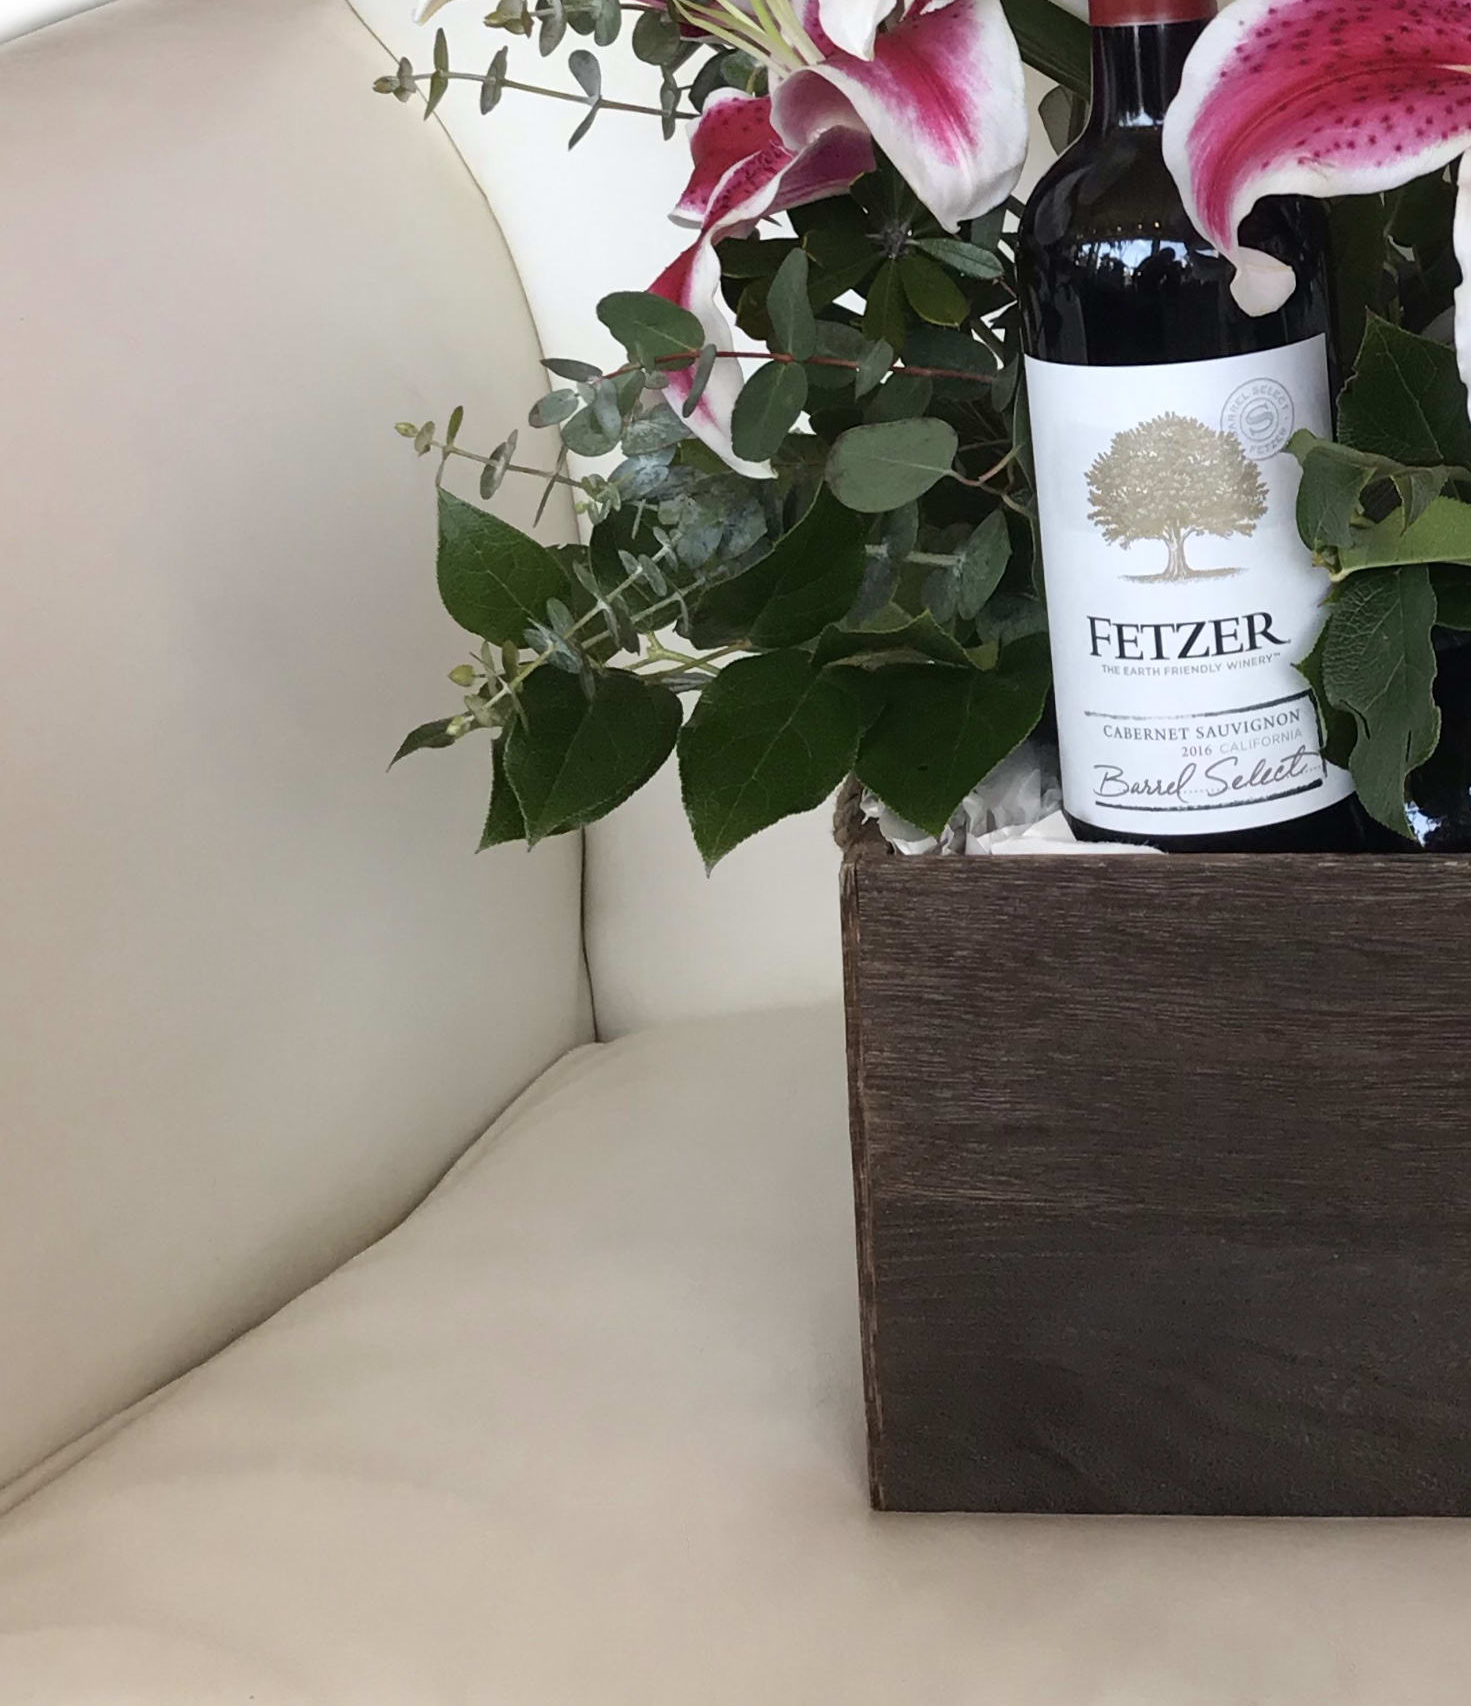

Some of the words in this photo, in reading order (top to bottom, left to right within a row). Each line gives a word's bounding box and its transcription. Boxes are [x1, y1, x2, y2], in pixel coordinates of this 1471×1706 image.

[1251, 384, 1289, 411] SELECT
[1086, 611, 1292, 661] FETZER
[1101, 663, 1121, 676] THE
[1123, 664, 1161, 677] EARTH
[1163, 662, 1223, 677] FRIENDLY
[1102, 724, 1190, 742] CABERNET
[1195, 709, 1301, 740] SAUVIGNON
[1181, 745, 1213, 758] 2016
[1218, 727, 1304, 755] CALIFORNIA
[1092, 761, 1198, 804] Barrel
[1204, 745, 1321, 798] Select
